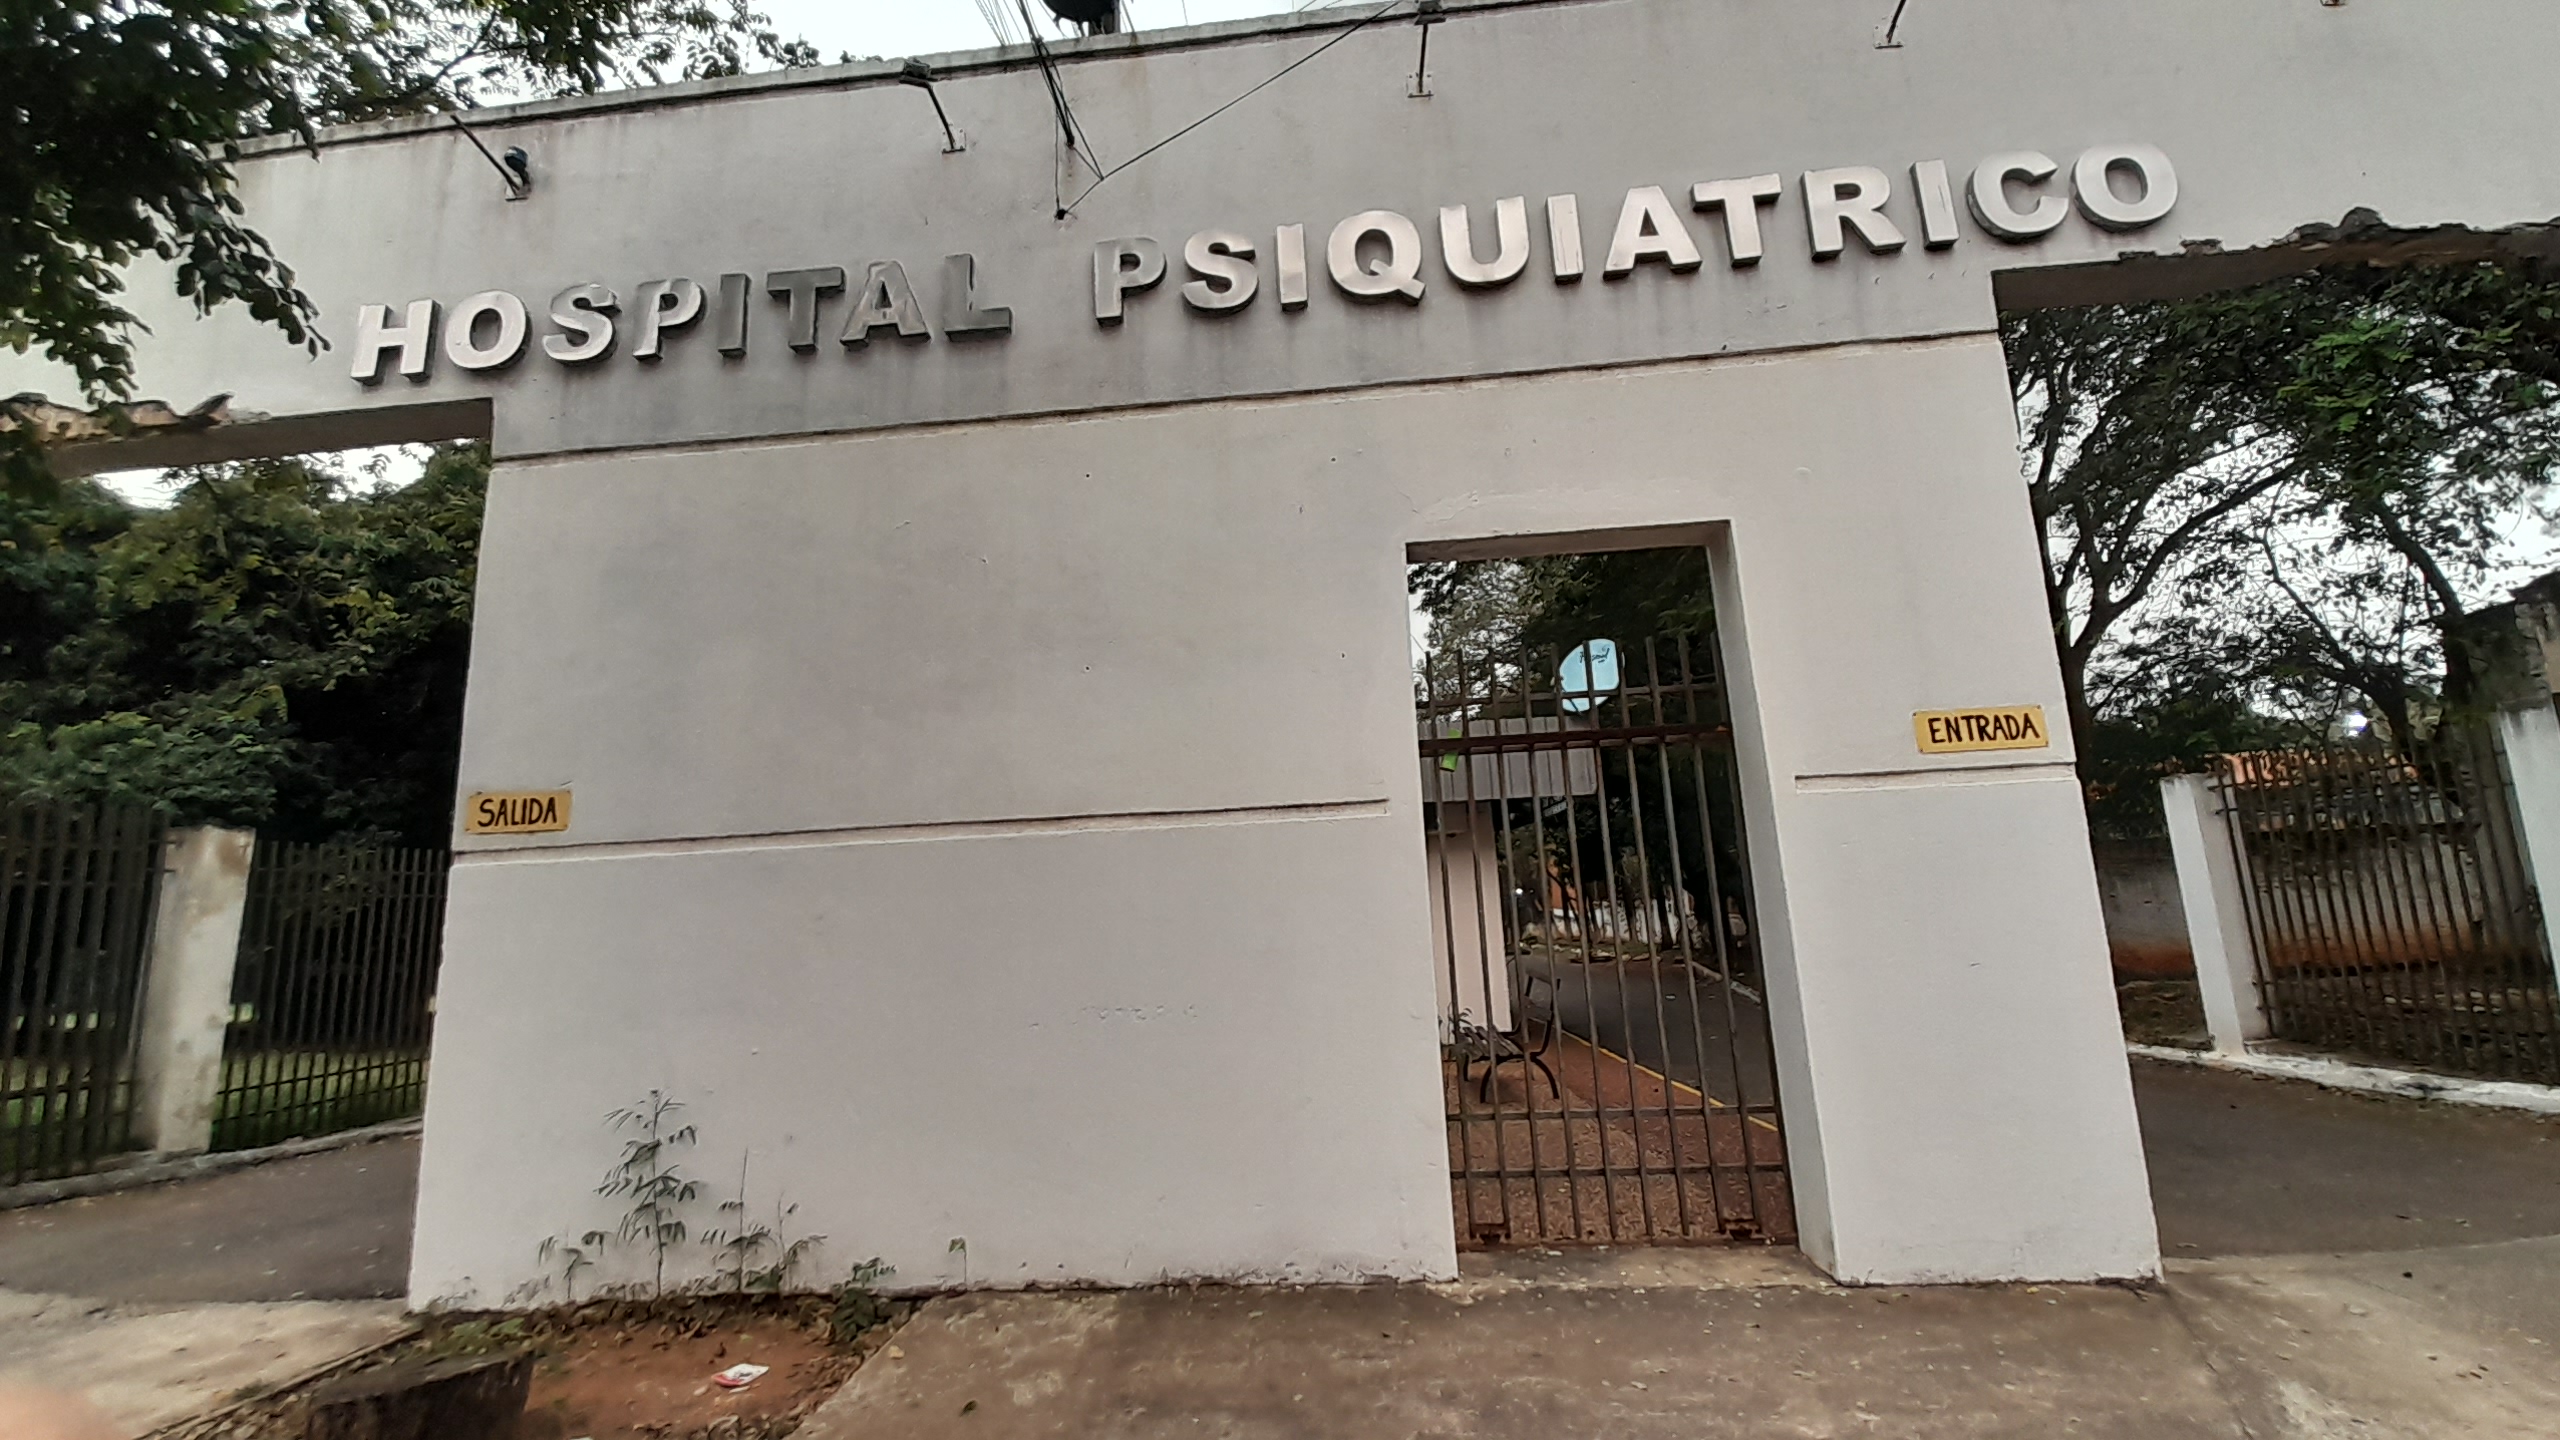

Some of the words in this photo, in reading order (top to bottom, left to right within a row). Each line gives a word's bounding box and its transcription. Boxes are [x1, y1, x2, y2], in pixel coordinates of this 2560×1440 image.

[351, 253, 1012, 387] HOSPITAL
[1093, 144, 2179, 325] PSIQUIATRICO
[1927, 712, 2040, 744] ENTRADA
[477, 796, 557, 827] SALIDA
